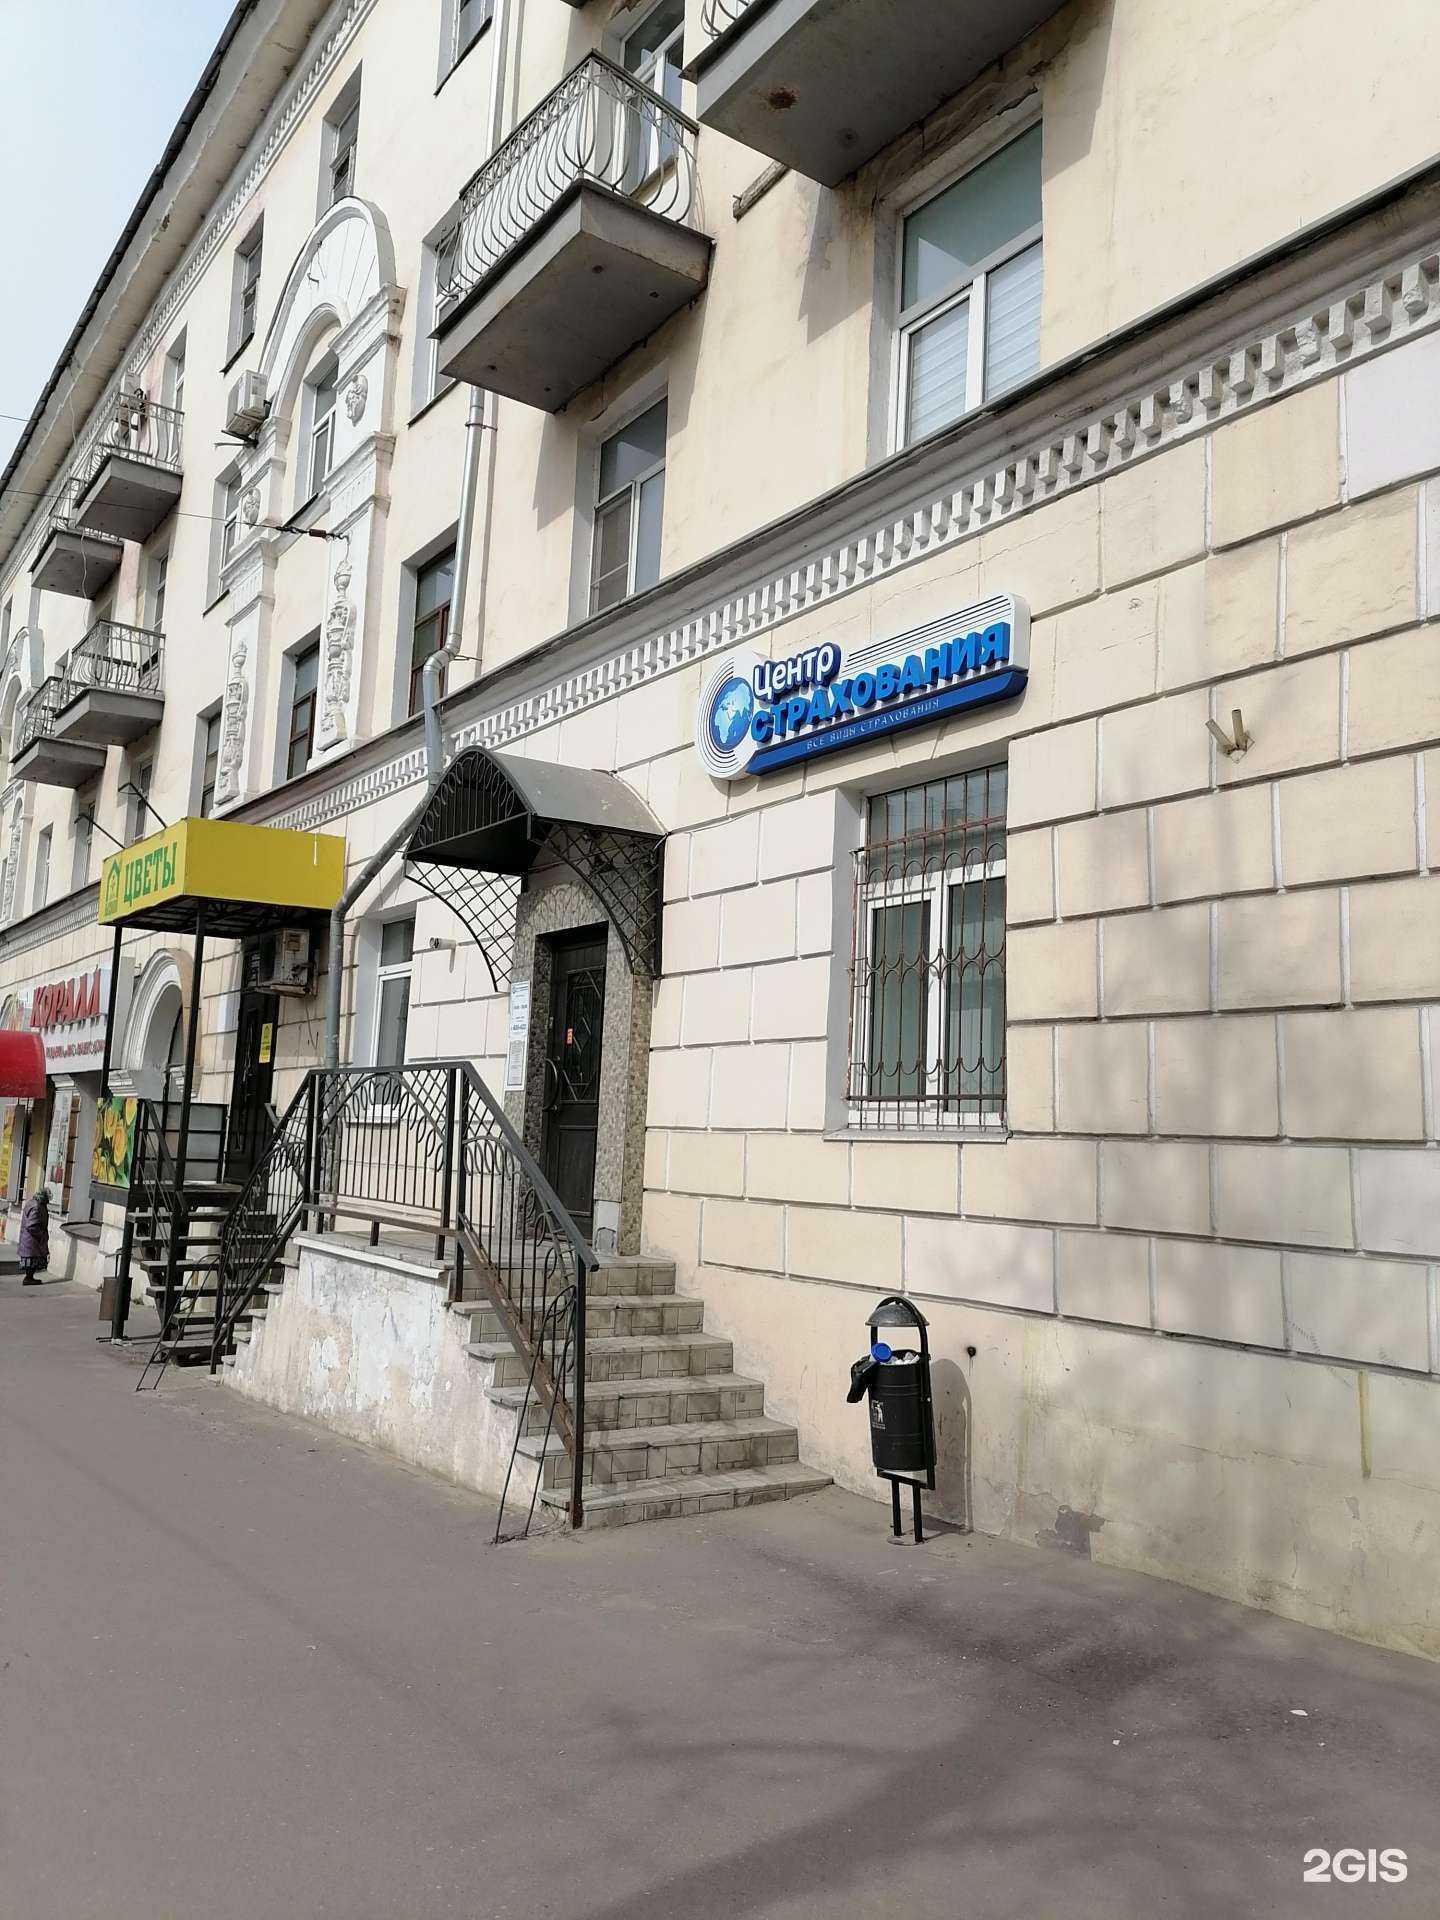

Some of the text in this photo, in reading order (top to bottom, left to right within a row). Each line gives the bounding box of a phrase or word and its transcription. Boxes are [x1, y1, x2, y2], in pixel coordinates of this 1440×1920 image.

[750, 622, 1011, 743] СТРАХОВАНИЯ
[754, 643, 838, 701] Центр
[806, 699, 940, 750] ВСЕ ВИДЫ СТРАХОВАНИЯ
[123, 842, 178, 907] ЦВЕТЫ
[30, 968, 101, 1027] КОРАЛЛ
